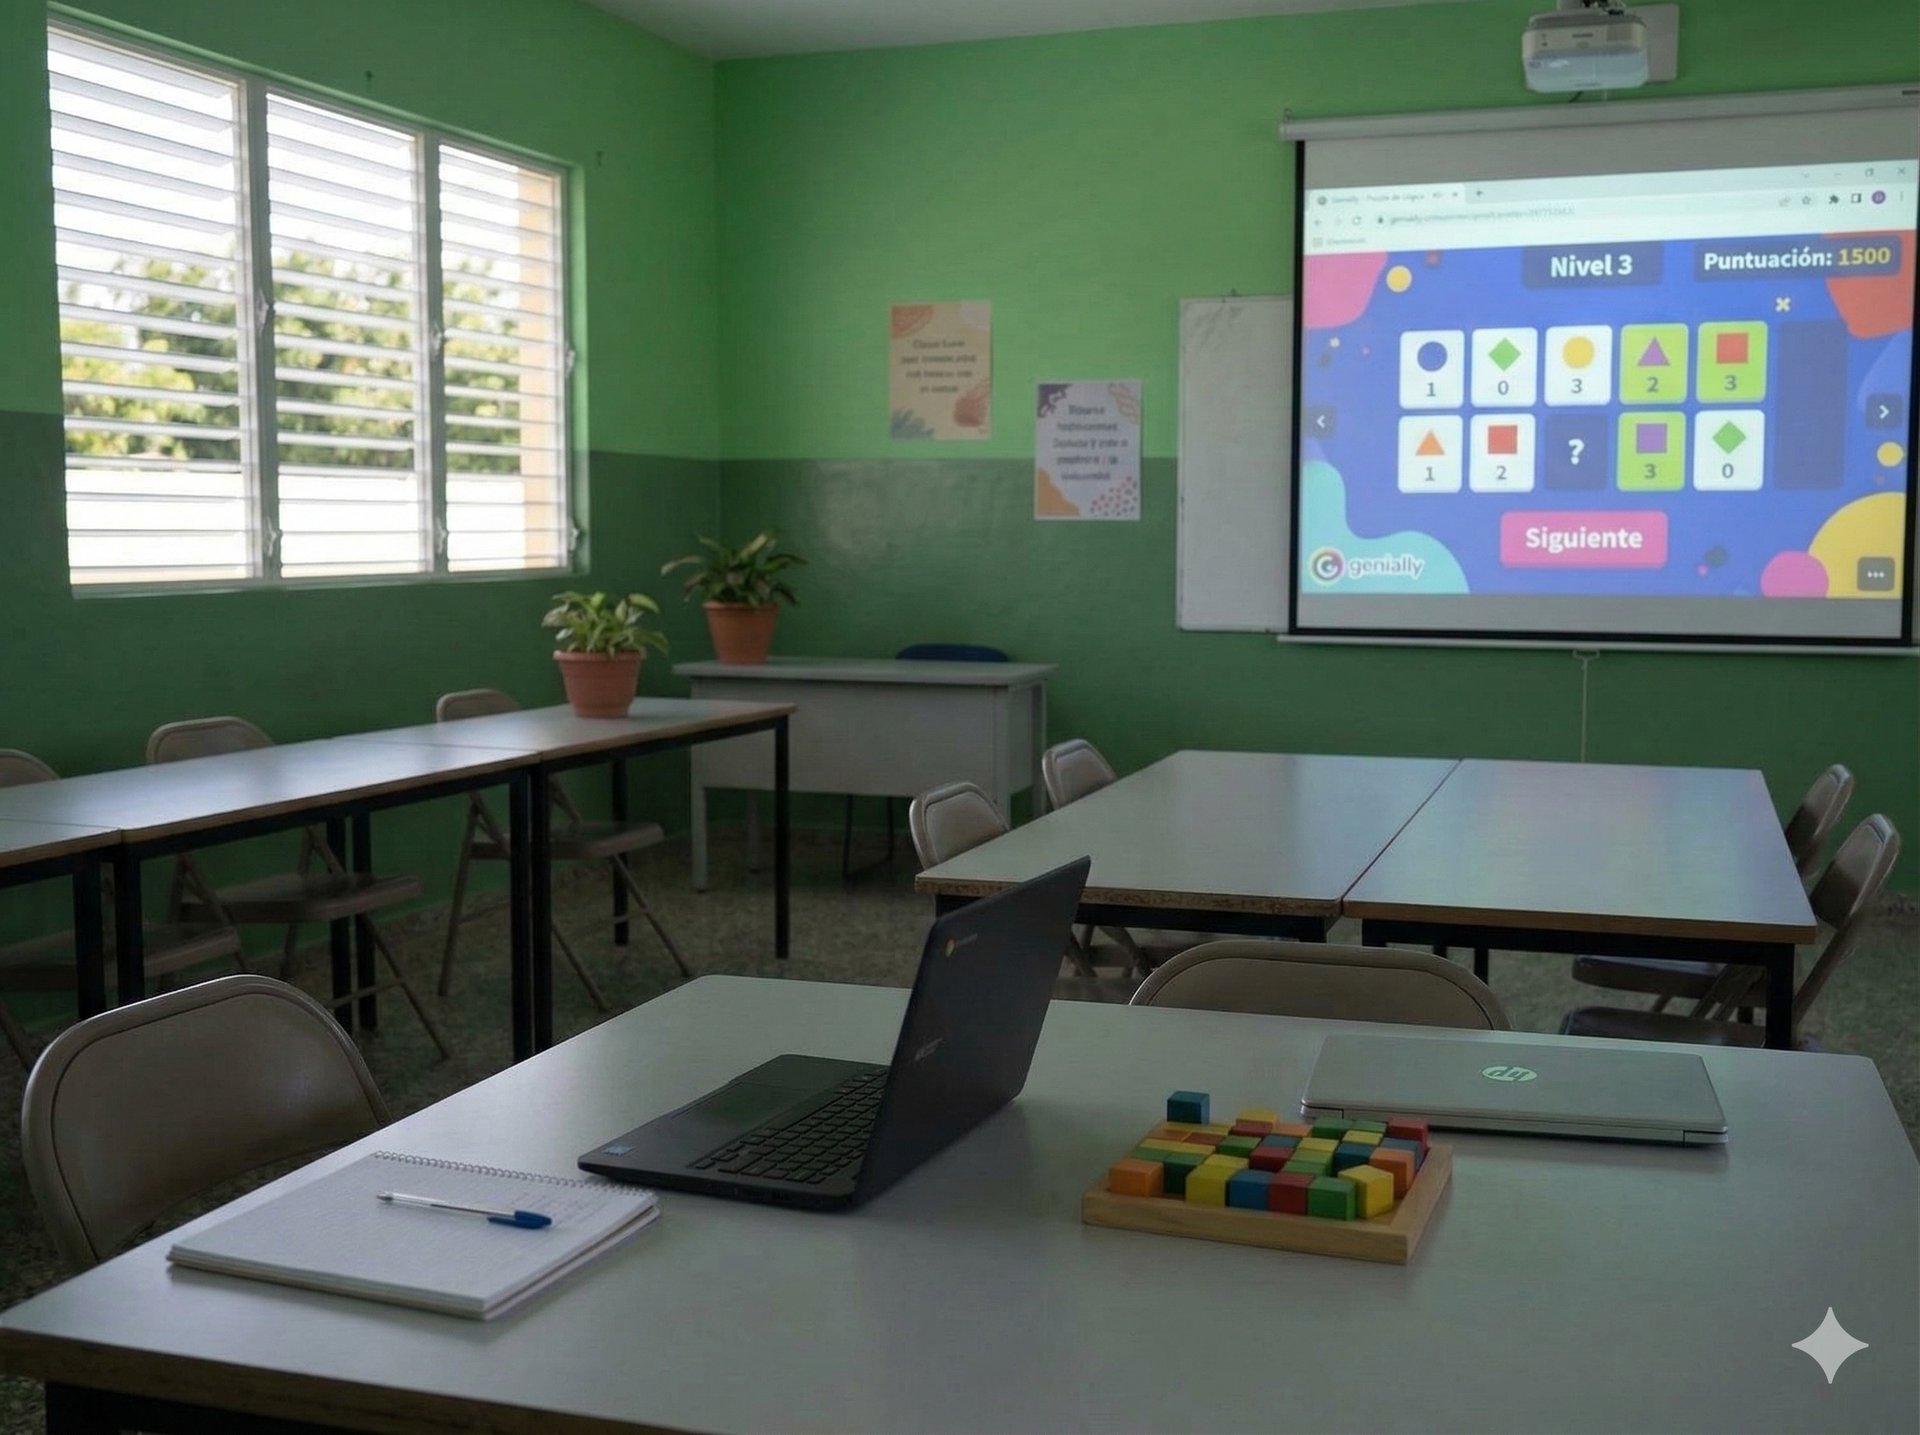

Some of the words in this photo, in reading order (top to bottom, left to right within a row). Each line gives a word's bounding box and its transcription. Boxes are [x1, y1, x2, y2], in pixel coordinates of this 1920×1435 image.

[1551, 253, 1613, 278] Nivel
[1617, 254, 1633, 275] 3
[1704, 246, 1833, 271] Puntuación:
[1838, 247, 1892, 266] 1500
[1426, 382, 1437, 397] 1
[1497, 380, 1509, 396] 0
[1571, 378, 1583, 394] 3
[1646, 376, 1659, 393] 2
[1724, 375, 1737, 391] 3
[1568, 438, 1585, 465] ?
[1425, 466, 1435, 482] 1
[1496, 465, 1507, 481] 2
[1644, 463, 1656, 480] 3
[1722, 463, 1734, 479] 0
[1525, 526, 1643, 554] Siguiente
[1348, 555, 1424, 578] genially
[1487, 1065, 1531, 1082] hp
